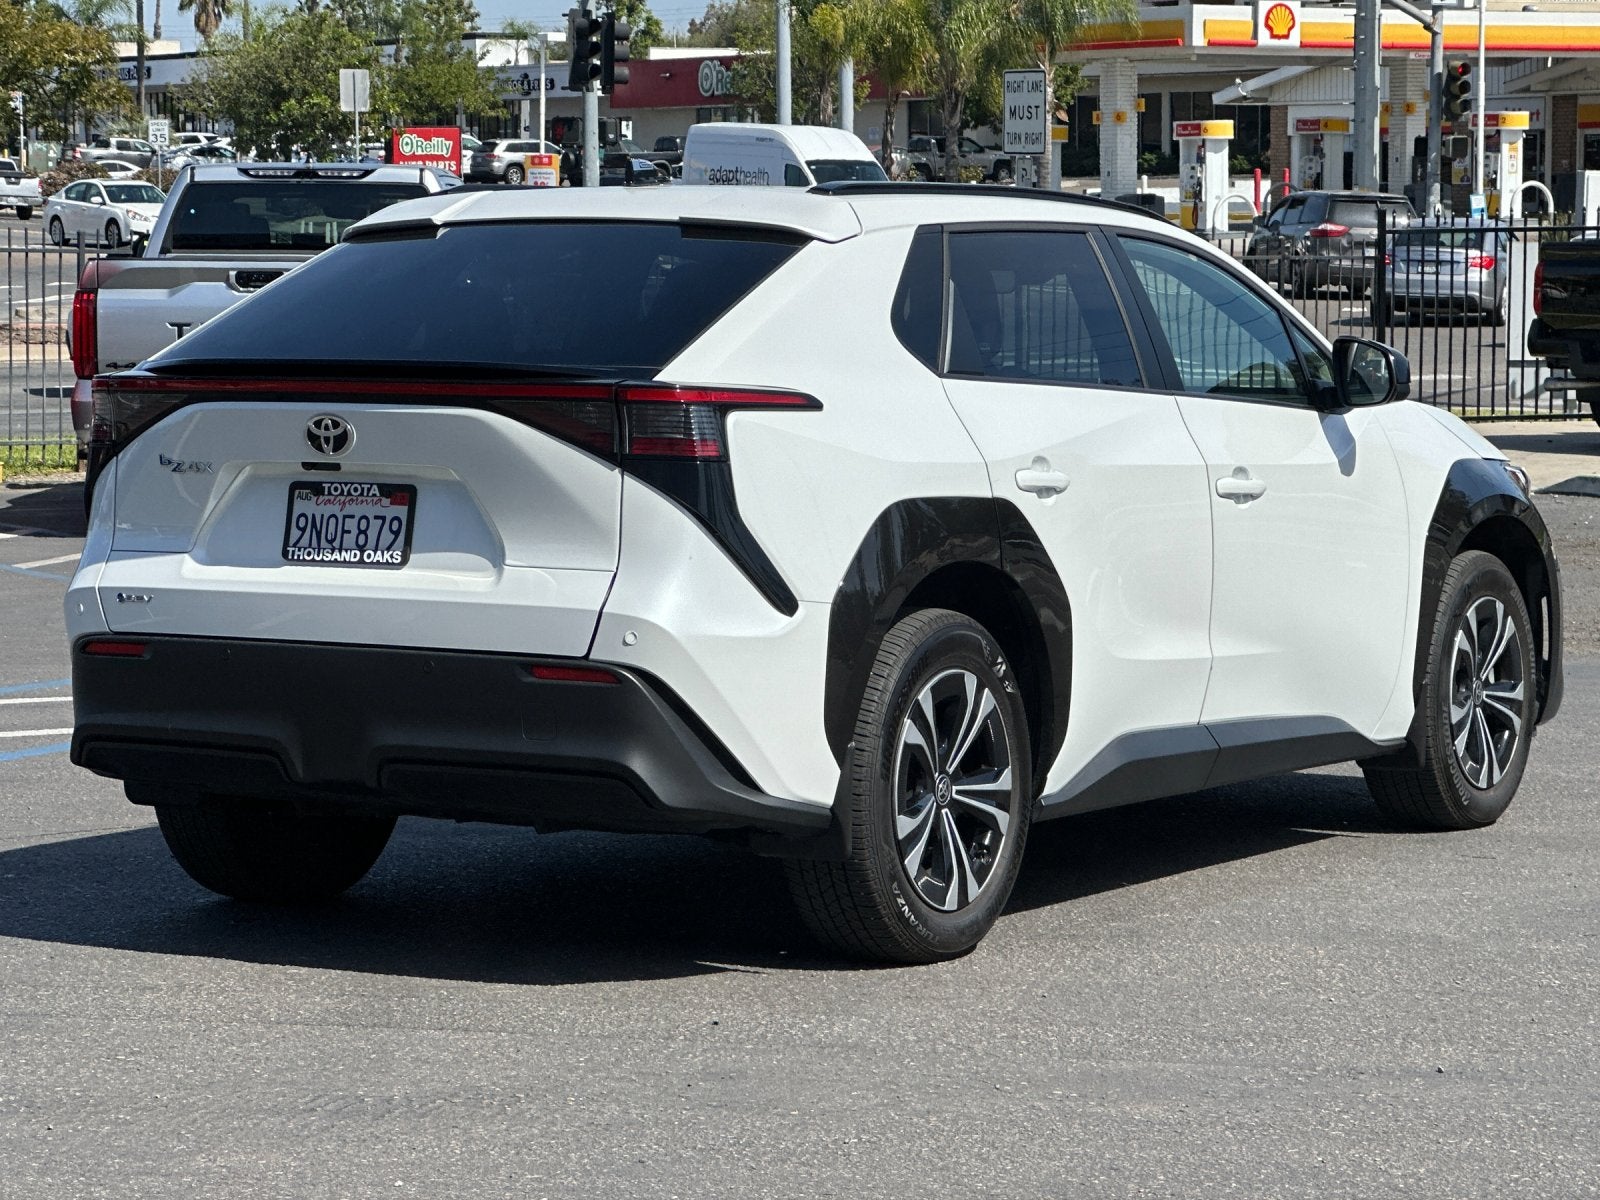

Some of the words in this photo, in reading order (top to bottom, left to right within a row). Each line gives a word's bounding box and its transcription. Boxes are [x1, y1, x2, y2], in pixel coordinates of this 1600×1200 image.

[1007, 80, 1024, 93] RIGHT
[1027, 80, 1042, 93] LANE
[1009, 105, 1040, 120] MUST
[1203, 126, 1209, 134] 6
[151, 133, 167, 143] 35
[400, 134, 453, 157] O'Reilly
[1007, 132, 1021, 145] TURN
[1025, 132, 1042, 145] RIGHT
[709, 165, 770, 184] adapthealth
[322, 483, 380, 496] TOYOTA
[296, 491, 312, 501] AUG
[315, 495, 390, 512] California
[293, 513, 403, 551] 9NQF879
[287, 547, 361, 562] THOUSAND
[363, 550, 402, 563] OAKS
[892, 881, 940, 943] TURANZA
